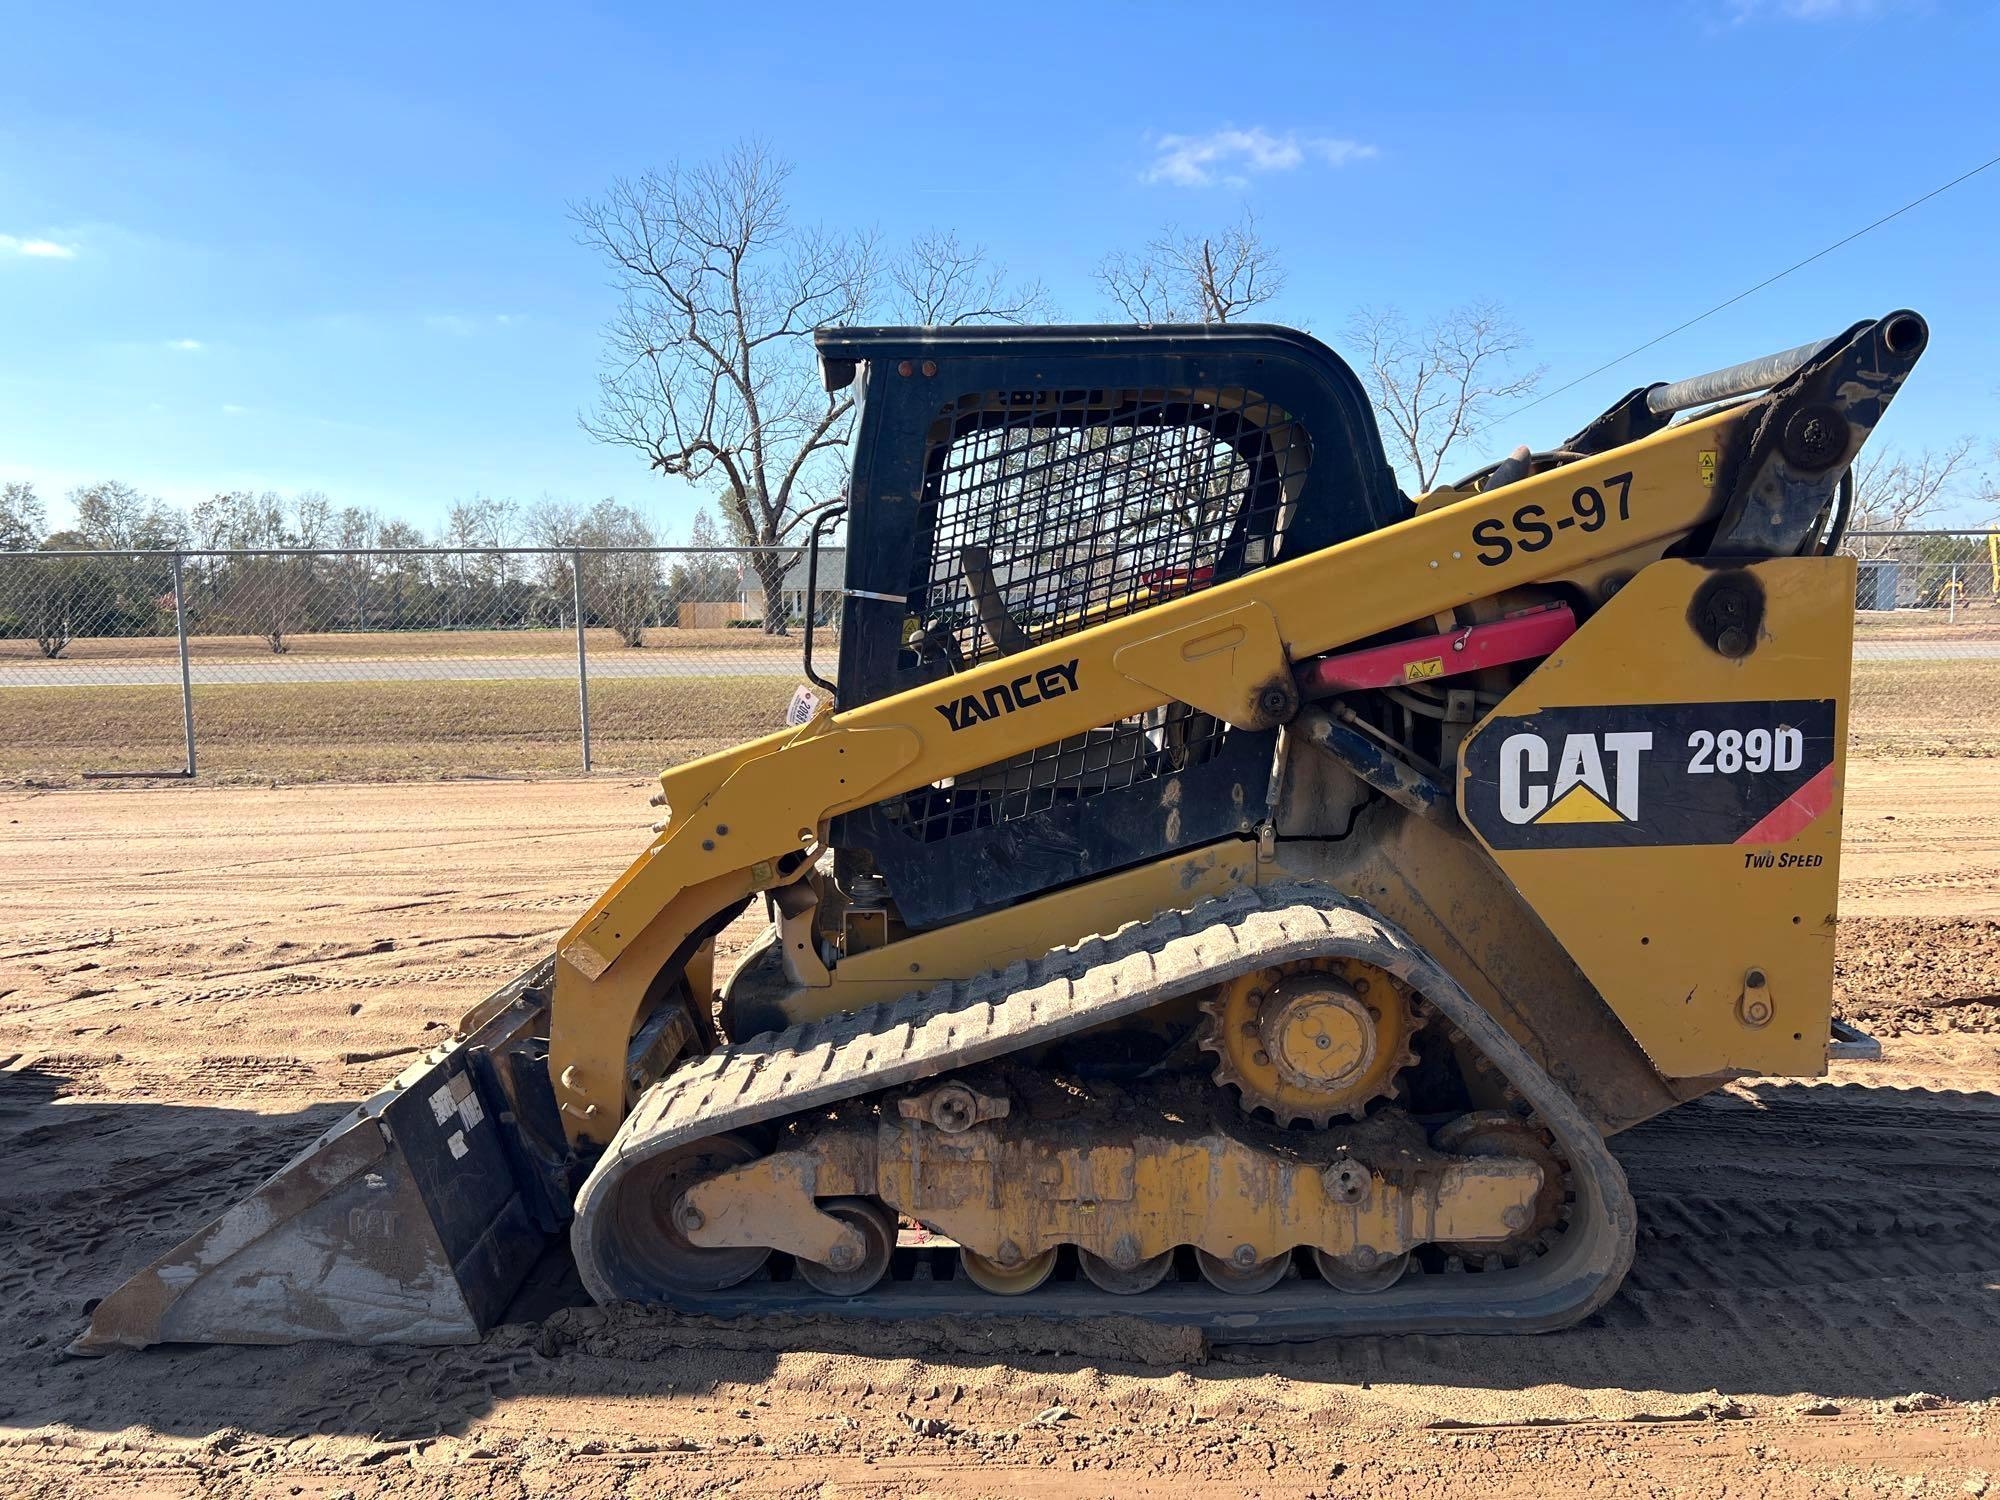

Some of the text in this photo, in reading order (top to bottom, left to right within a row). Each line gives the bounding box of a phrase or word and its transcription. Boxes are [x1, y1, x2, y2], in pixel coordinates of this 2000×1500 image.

[1472, 471, 1633, 566] SS-97
[935, 658, 1079, 731] YANCEY
[1499, 732, 1653, 824] CAT
[1687, 728, 1803, 774] 289D
[1778, 852, 1823, 868] SPEED
